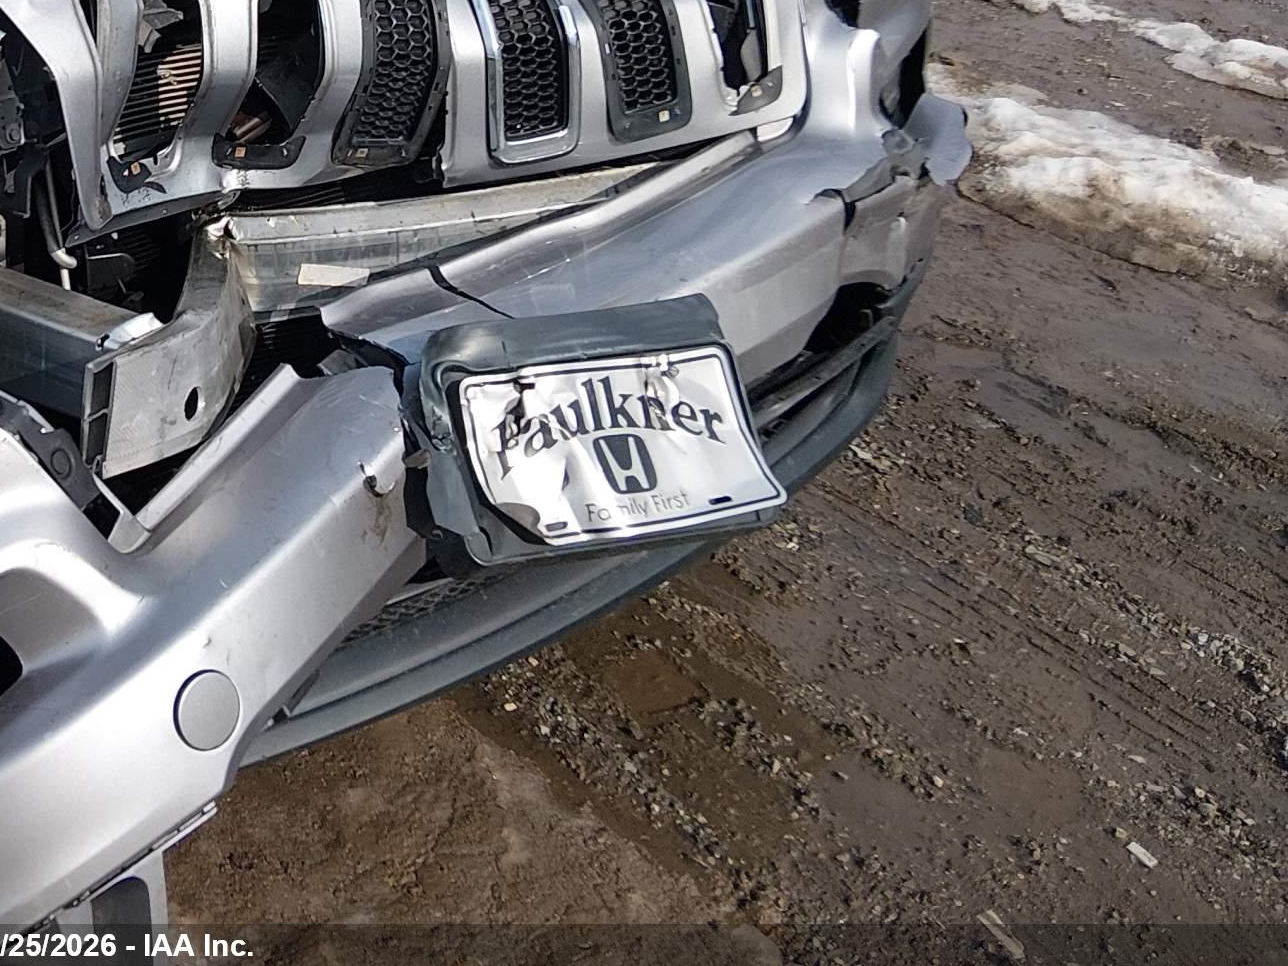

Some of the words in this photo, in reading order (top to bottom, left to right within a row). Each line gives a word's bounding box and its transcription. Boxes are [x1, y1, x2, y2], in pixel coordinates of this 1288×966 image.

[491, 375, 727, 482] Faulkner
[585, 496, 649, 523] Family
[653, 489, 692, 511] First
